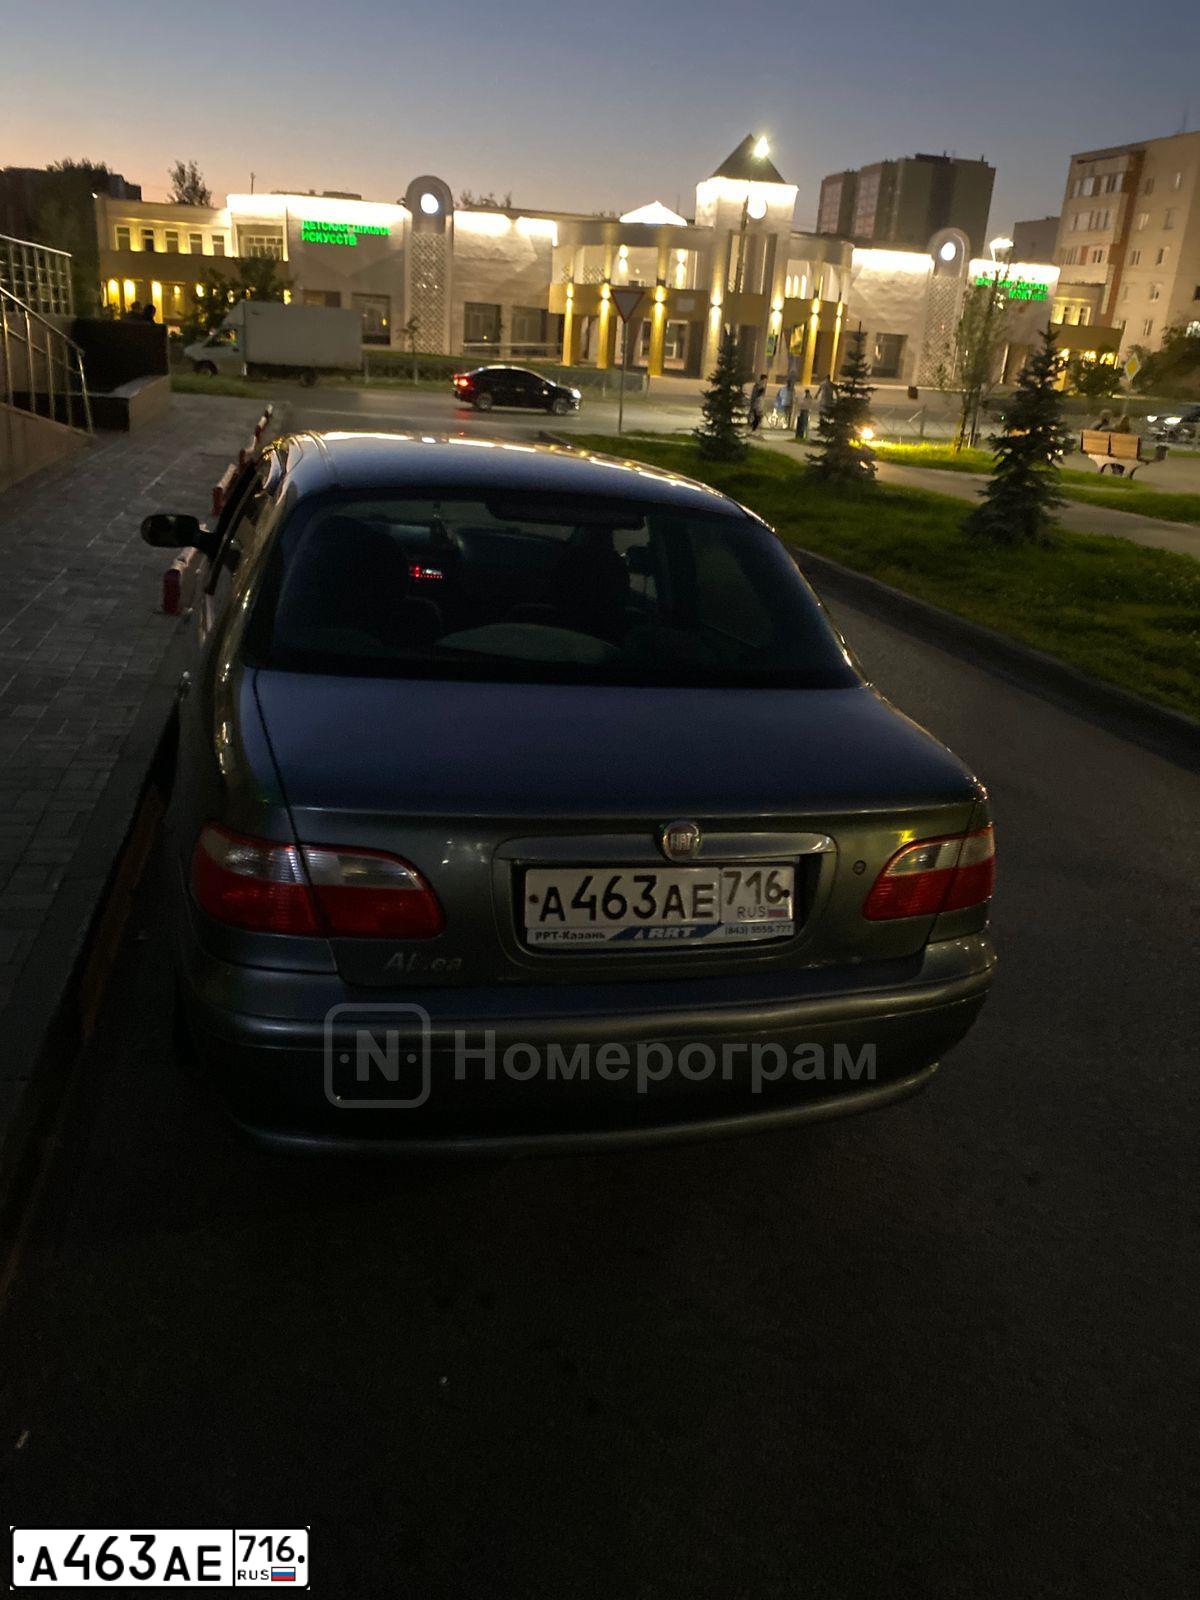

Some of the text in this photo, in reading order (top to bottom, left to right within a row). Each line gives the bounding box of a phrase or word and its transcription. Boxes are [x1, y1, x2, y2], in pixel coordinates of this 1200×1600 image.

[539, 871, 782, 921] А463АЕ 716
[737, 907, 766, 918] RUS
[384, 952, 464, 972] Alea
